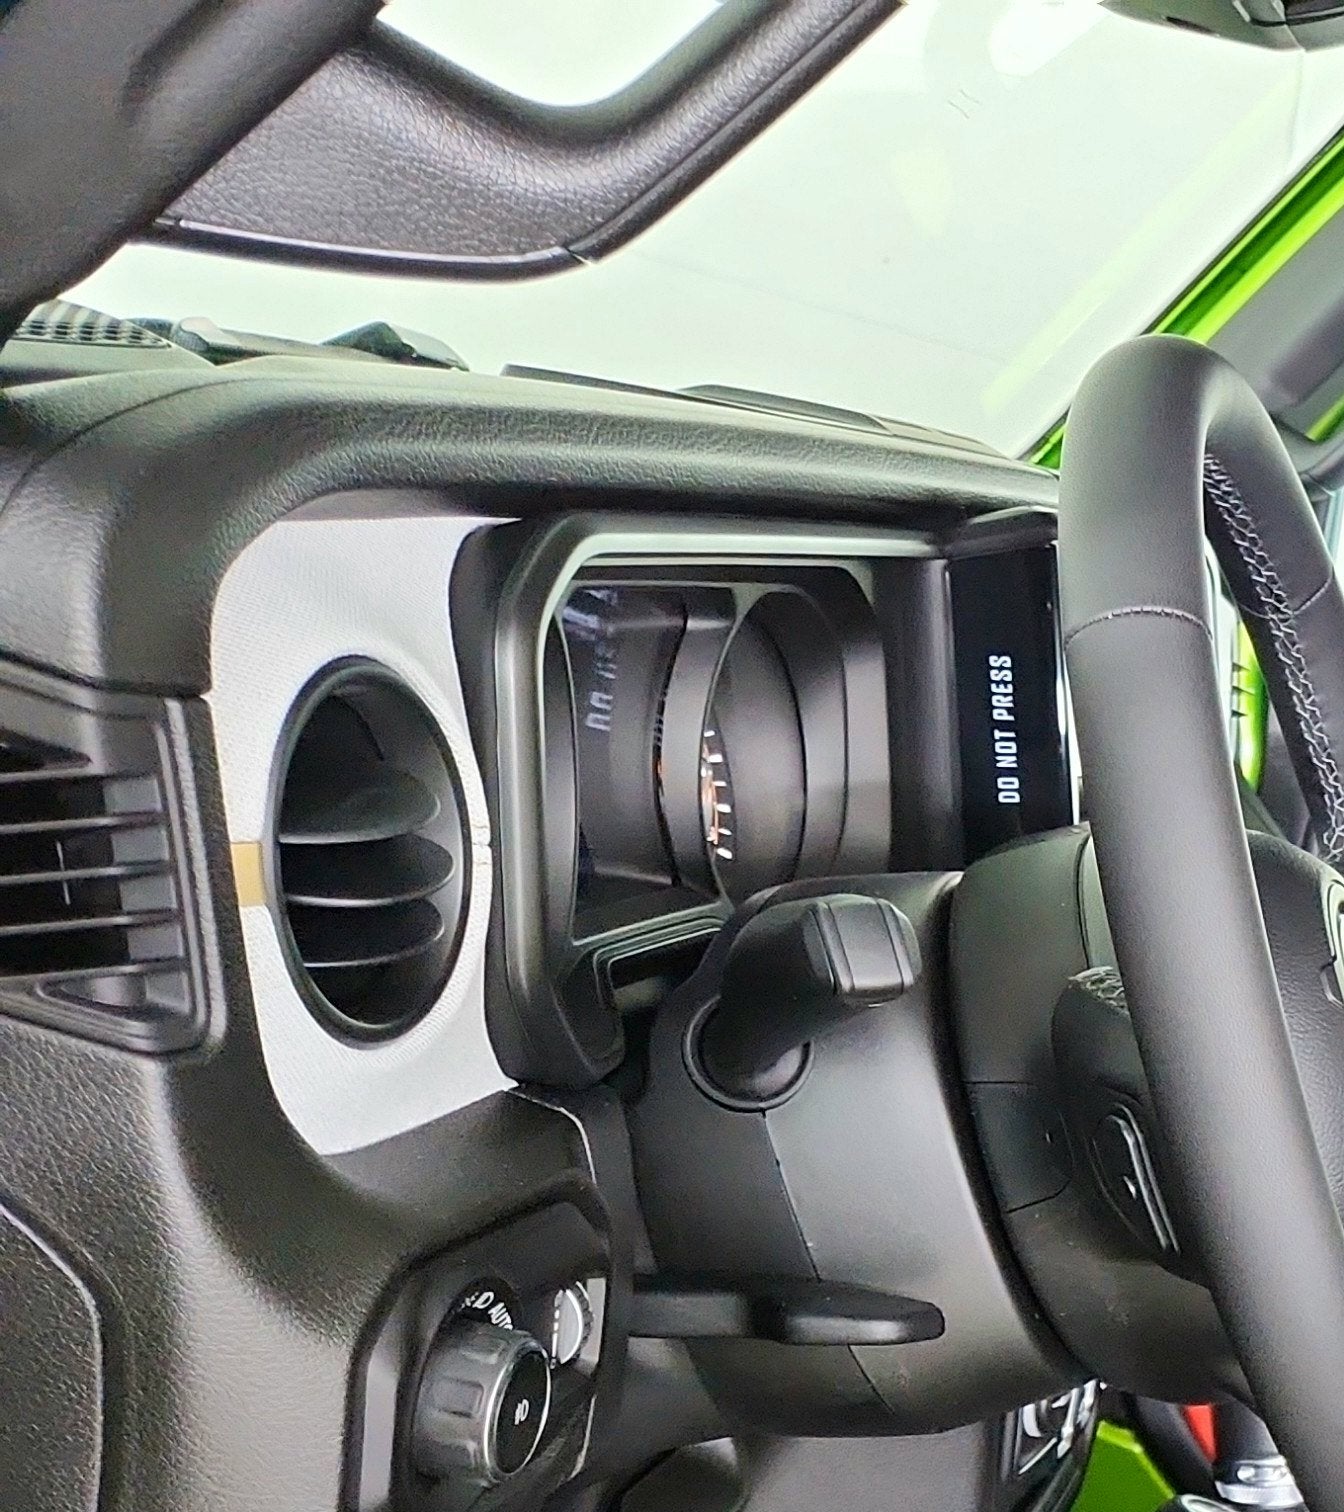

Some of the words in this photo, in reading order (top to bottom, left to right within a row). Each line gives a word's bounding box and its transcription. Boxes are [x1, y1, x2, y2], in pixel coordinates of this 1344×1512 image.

[988, 655, 1016, 722] PRESS
[993, 728, 1019, 769] NOT
[996, 776, 1021, 804] DO
